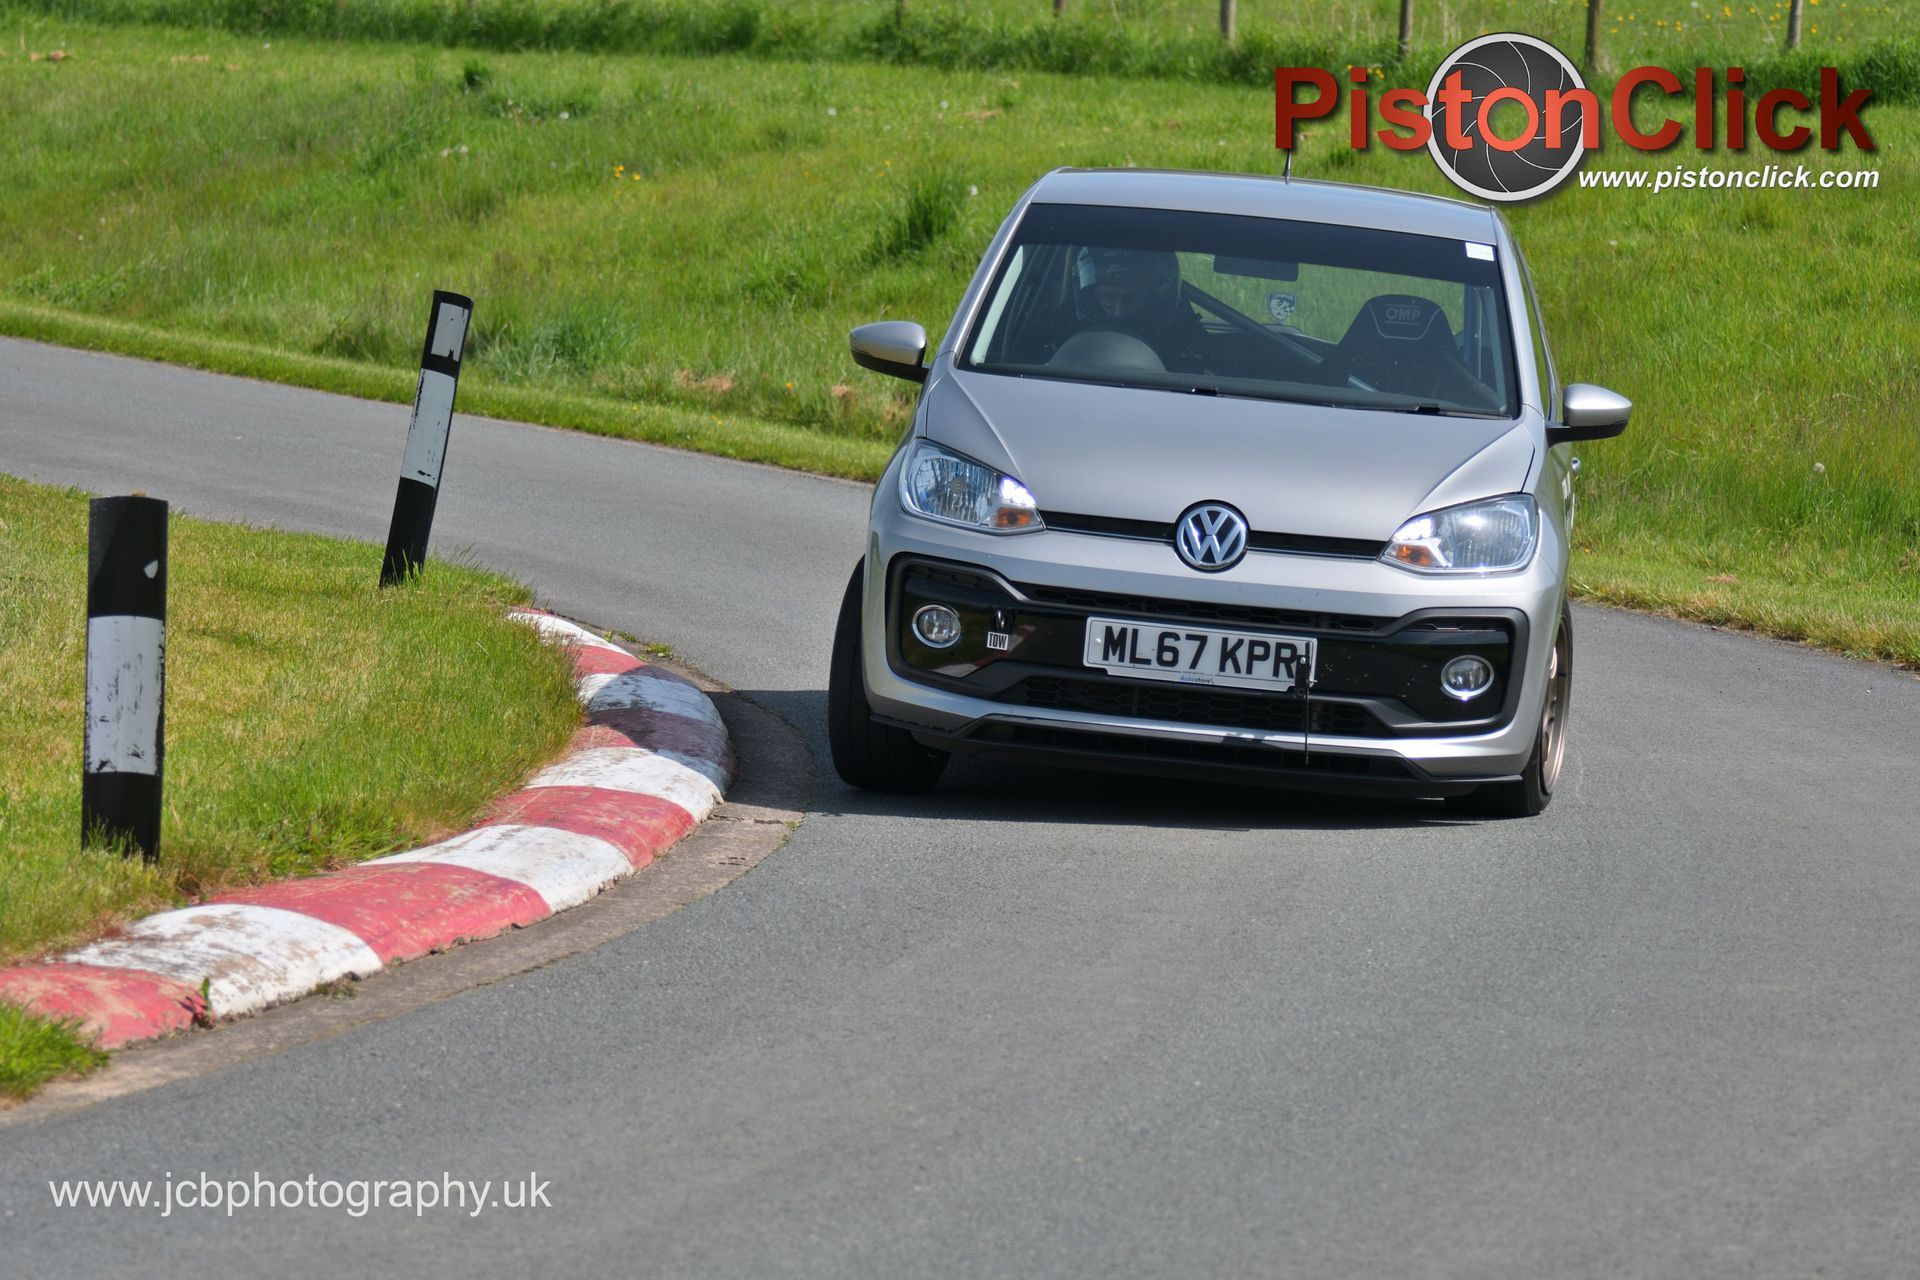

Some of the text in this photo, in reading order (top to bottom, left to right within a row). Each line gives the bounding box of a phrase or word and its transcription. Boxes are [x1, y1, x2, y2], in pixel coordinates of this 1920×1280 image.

[1385, 307, 1421, 321] OMP
[1179, 506, 1245, 564] VW
[988, 633, 1007, 649] TOW
[1102, 625, 1298, 680] ML67 KPR
